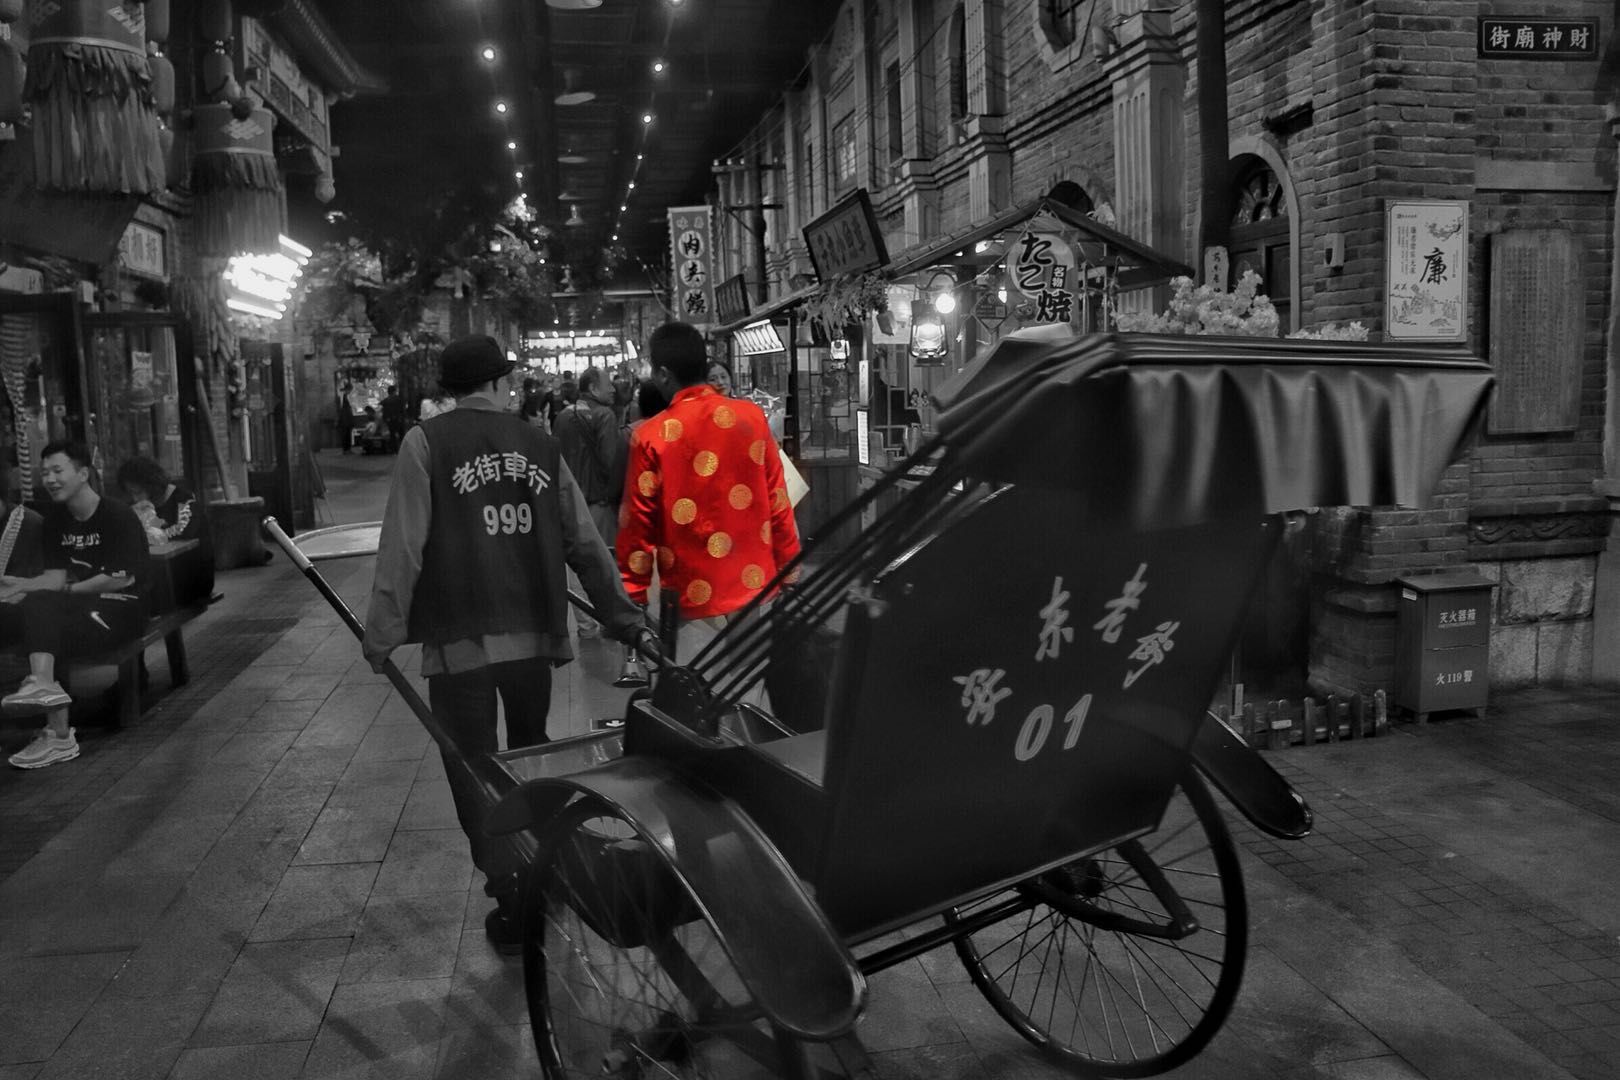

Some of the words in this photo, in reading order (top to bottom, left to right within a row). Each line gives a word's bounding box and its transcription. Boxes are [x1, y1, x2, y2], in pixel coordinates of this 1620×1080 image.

[1419, 247, 1448, 285] 廉
[452, 451, 551, 496] 老街車行
[483, 503, 533, 536] 999
[1439, 608, 1477, 624] 灭火器箱
[1014, 693, 1094, 762] 01
